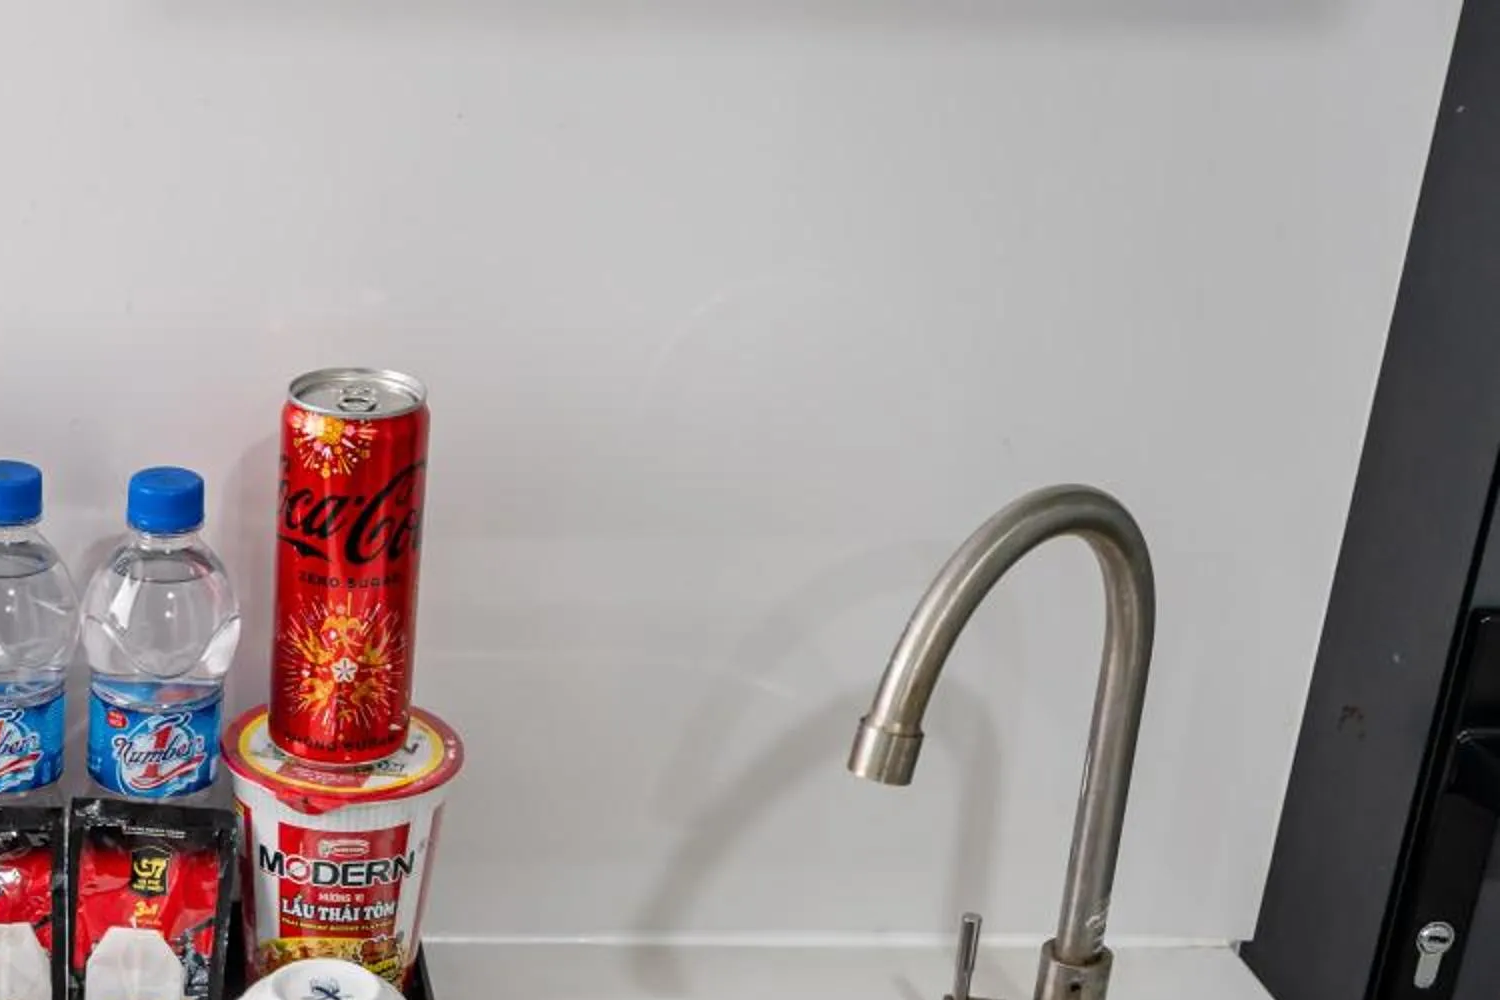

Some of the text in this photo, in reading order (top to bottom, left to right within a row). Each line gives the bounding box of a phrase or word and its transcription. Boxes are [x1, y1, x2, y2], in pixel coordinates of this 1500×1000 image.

[259, 844, 415, 886] MODERN
[318, 903, 359, 922] THÁI
[363, 898, 397, 920] TÔM
